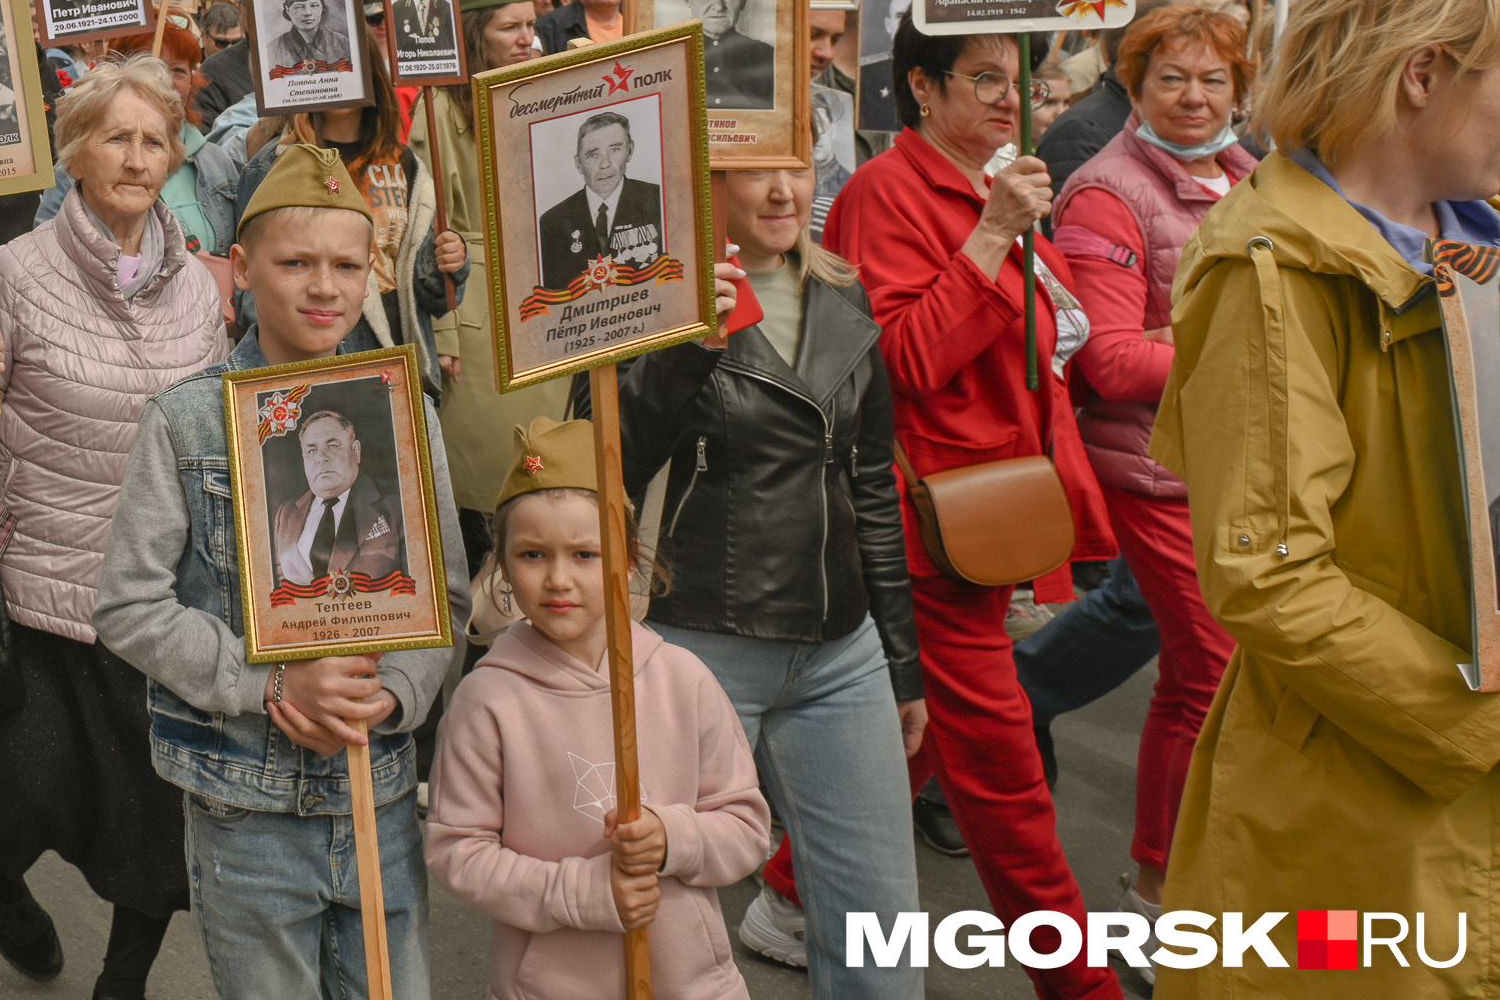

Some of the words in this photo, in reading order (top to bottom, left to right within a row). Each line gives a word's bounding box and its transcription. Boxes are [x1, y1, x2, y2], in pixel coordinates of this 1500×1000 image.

[52, 7, 81, 18] Петр
[966, 8, 1004, 17] 14.02.1919
[1010, 7, 1027, 15] 1942
[55, 12, 139, 31] 29.06.1921-24.11.2000
[415, 36, 436, 44] Попов
[397, 49, 417, 60] Игорь
[417, 48, 457, 57] Николаевич
[287, 79, 317, 87] Попова
[318, 76, 339, 84] Анна
[289, 86, 338, 97] Степановна
[707, 120, 737, 128] тянов
[708, 134, 756, 142] сильевич
[560, 288, 649, 324] Дмитриев
[546, 322, 587, 342] Пётр
[589, 303, 661, 331] Иванович
[564, 335, 596, 353] (1925
[603, 326, 631, 342] 2007
[315, 600, 372, 613] Тептеев
[281, 617, 327, 630] Андрей
[330, 611, 411, 626] Филиппович
[313, 629, 340, 641] 1926
[352, 626, 381, 638] 2007
